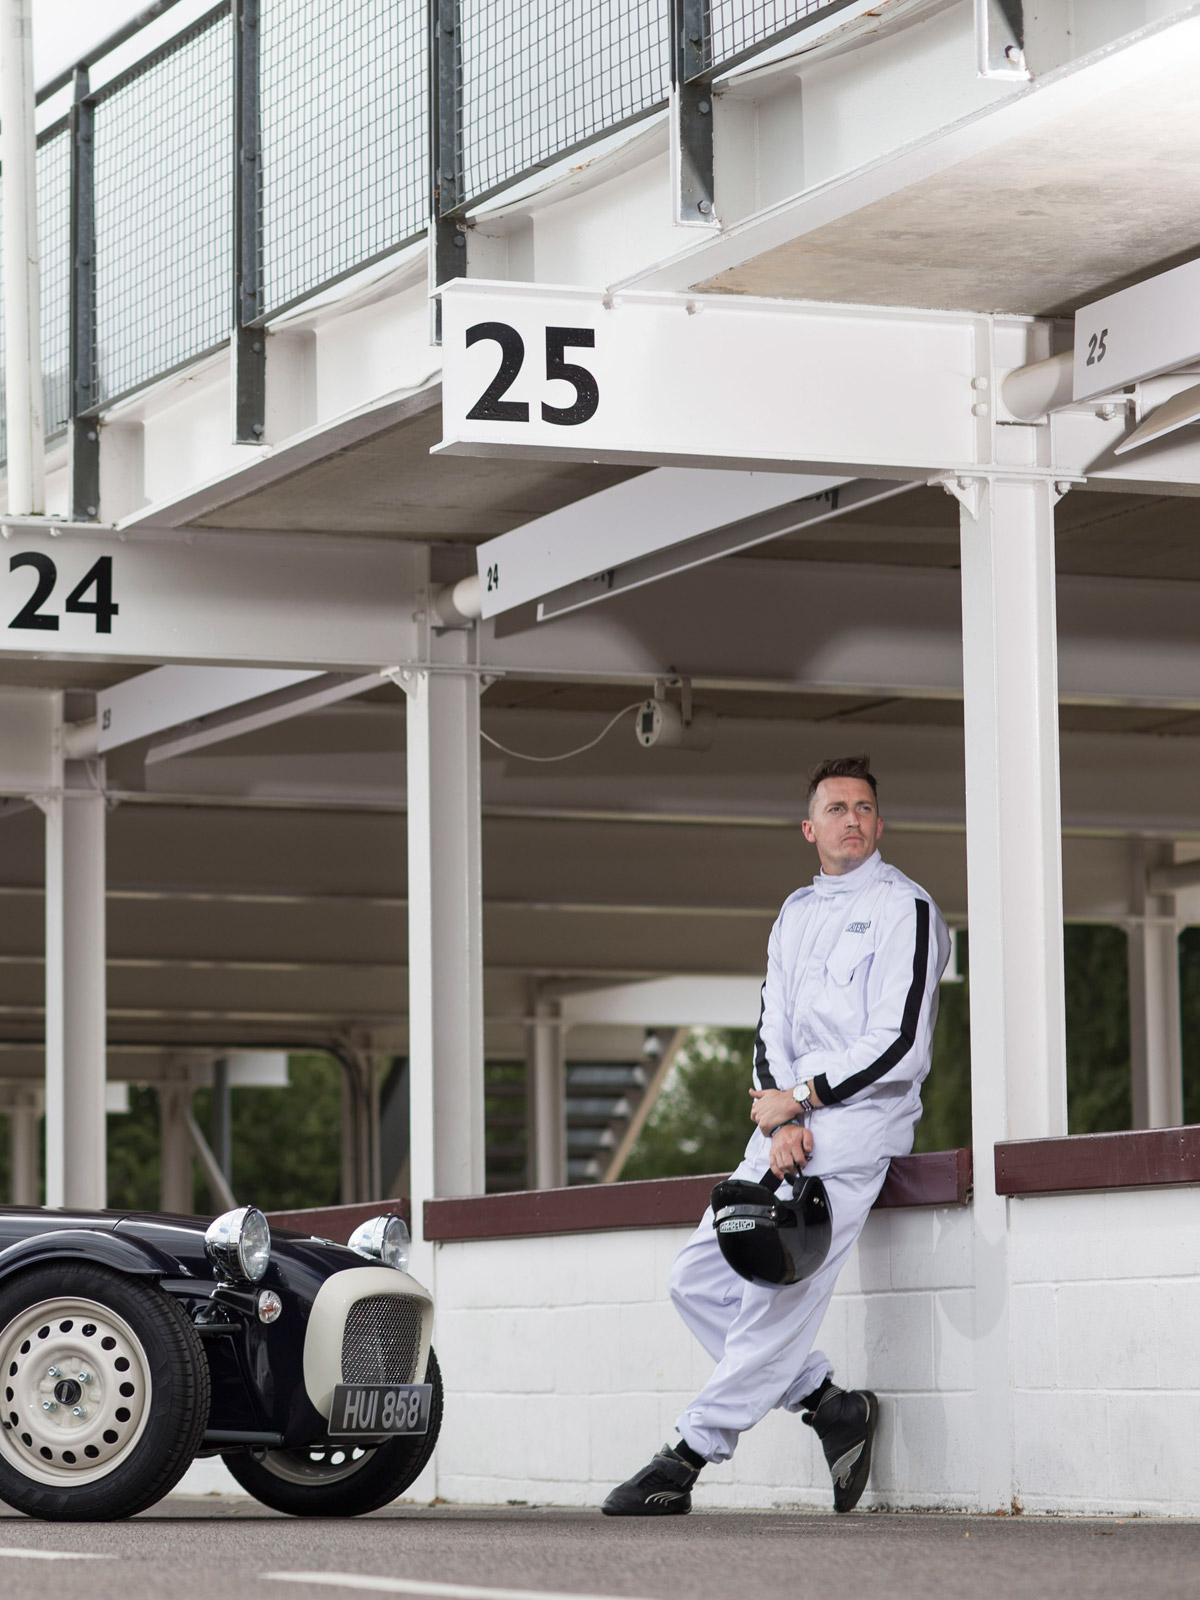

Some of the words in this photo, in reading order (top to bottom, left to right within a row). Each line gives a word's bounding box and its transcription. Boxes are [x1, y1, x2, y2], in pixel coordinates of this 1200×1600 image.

[1086, 328, 1108, 367] 25
[465, 321, 600, 426] 25
[7, 551, 120, 635] 24
[487, 563, 499, 592] 24
[342, 1390, 380, 1429] HUI
[382, 1390, 420, 1429] 858
